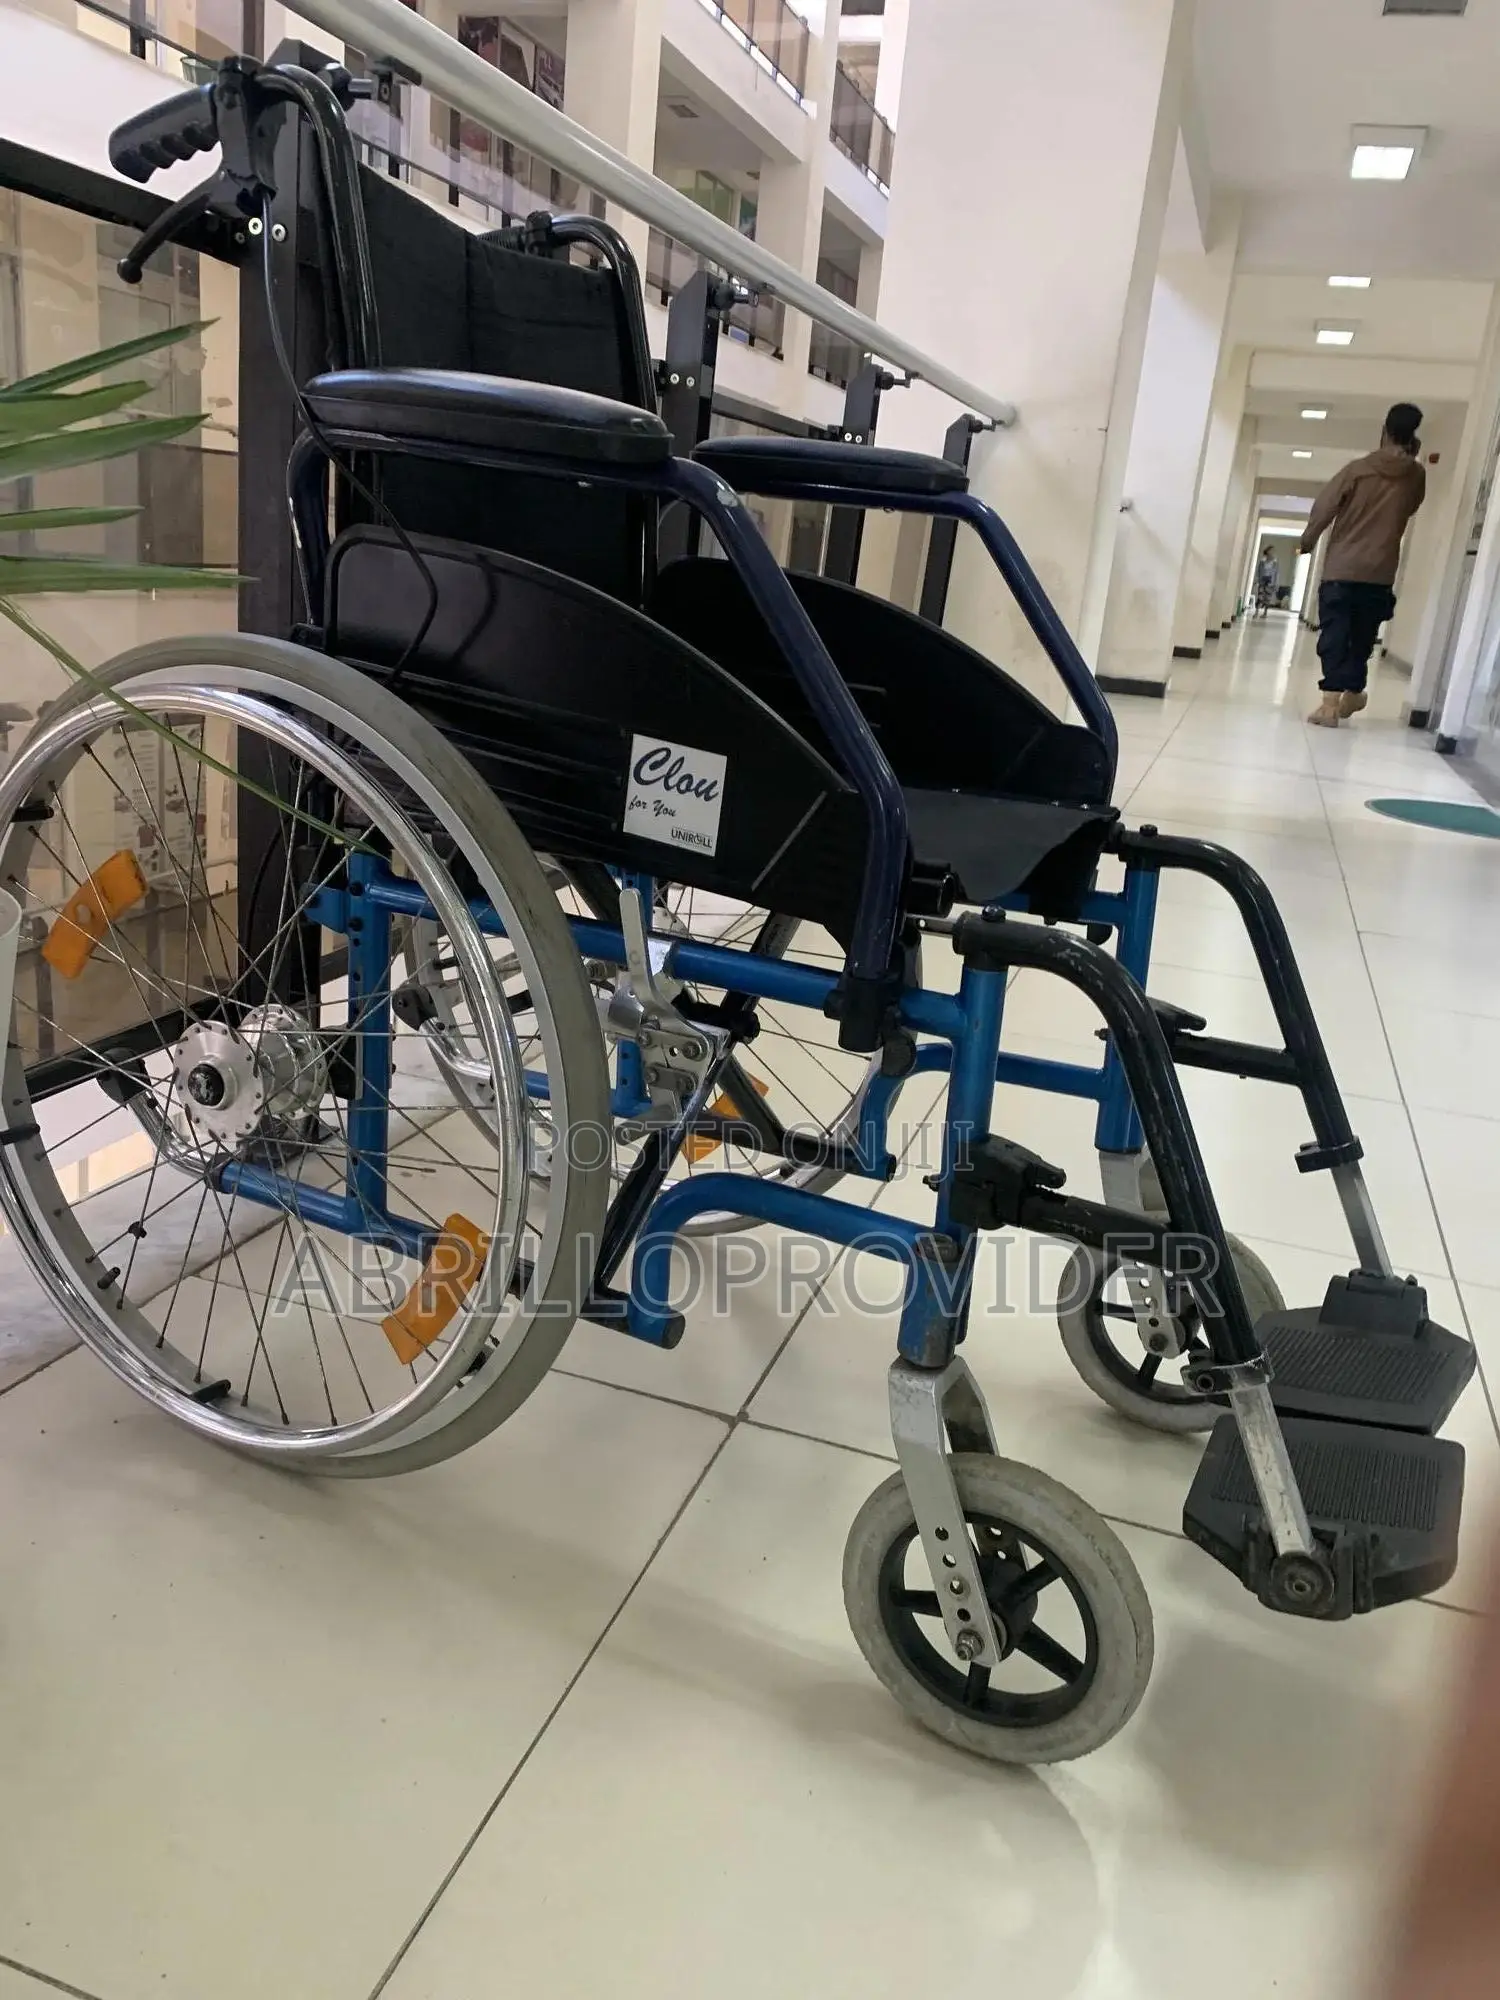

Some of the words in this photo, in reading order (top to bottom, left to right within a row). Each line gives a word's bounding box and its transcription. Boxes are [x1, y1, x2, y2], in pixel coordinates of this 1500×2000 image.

[633, 747, 719, 802] Clou
[628, 794, 648, 811] for
[653, 799, 677, 818] You
[671, 827, 713, 849] UNIROLL
